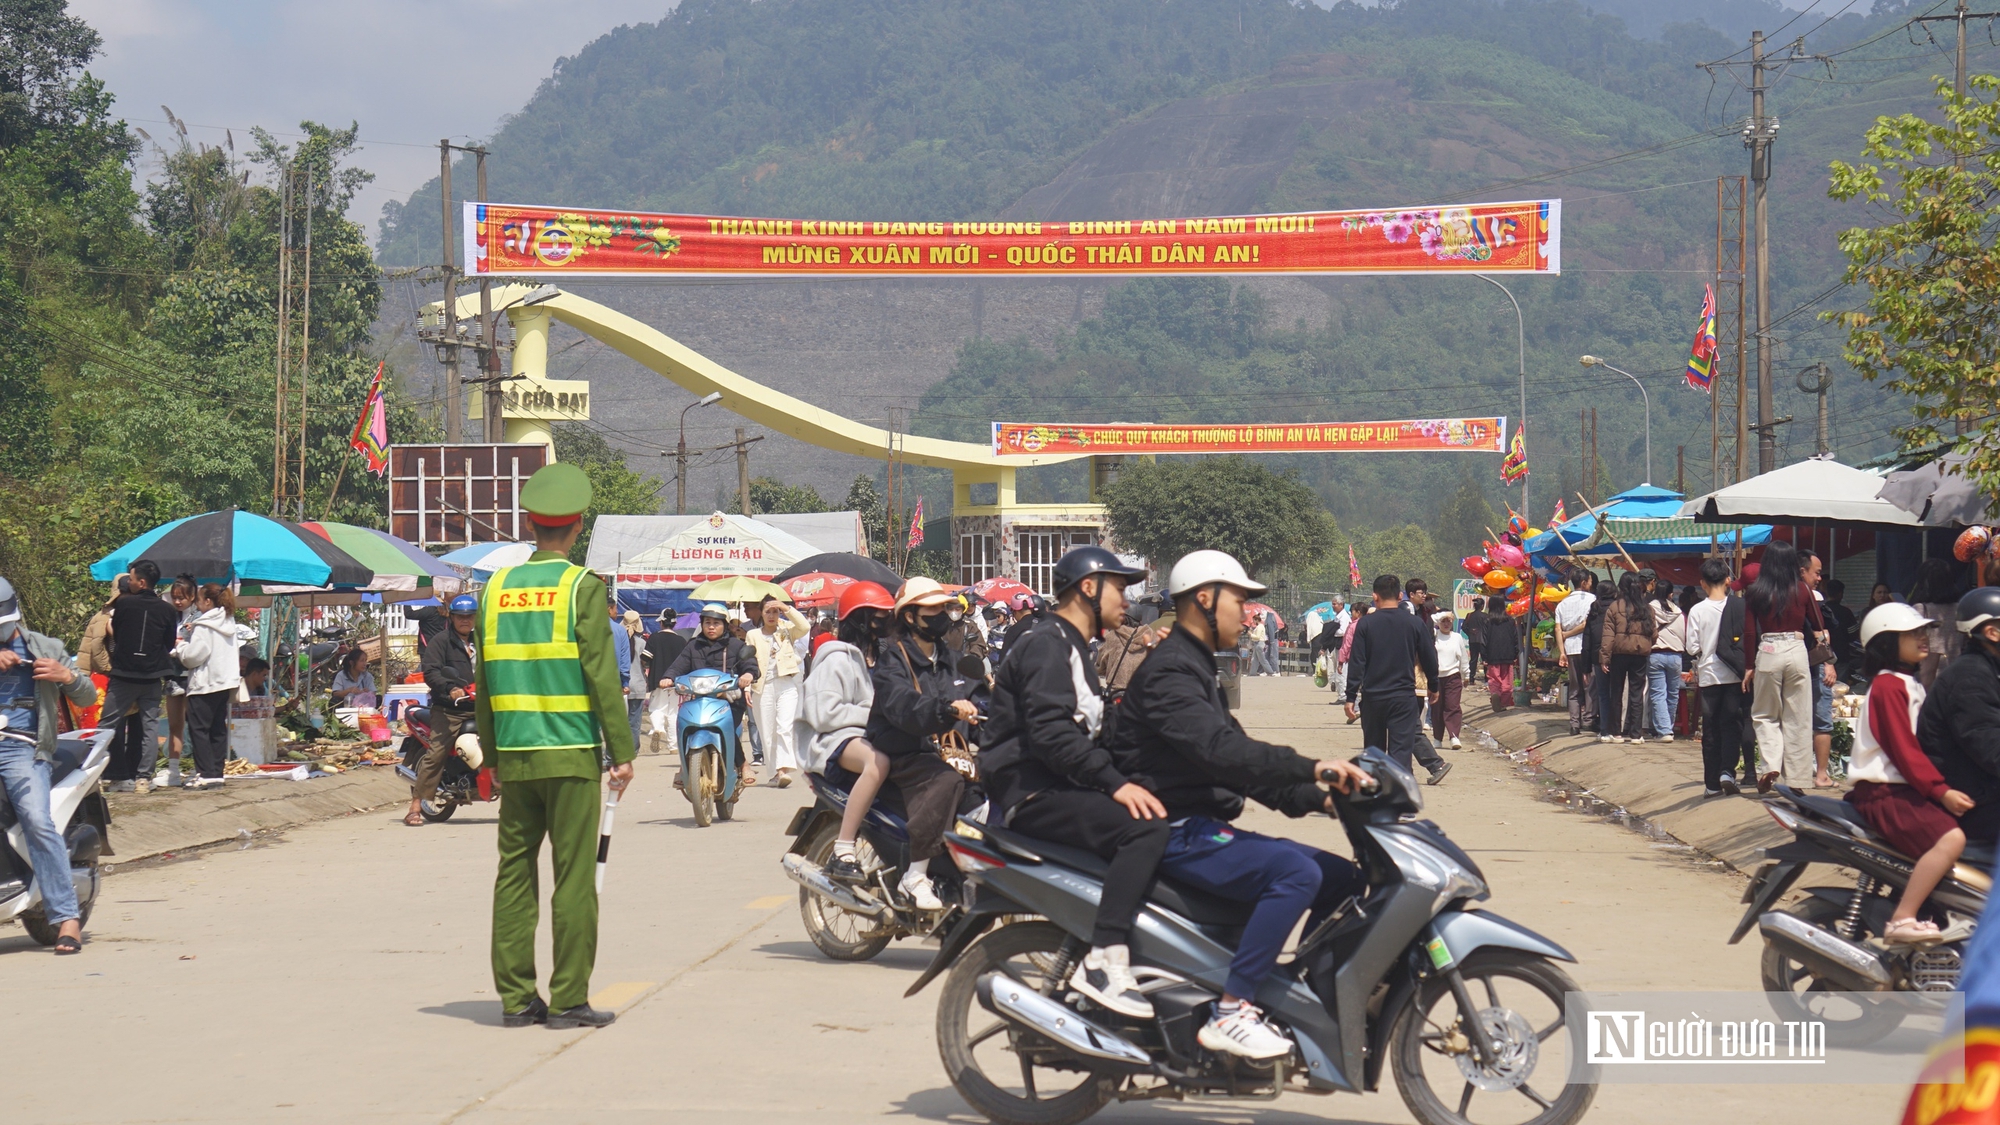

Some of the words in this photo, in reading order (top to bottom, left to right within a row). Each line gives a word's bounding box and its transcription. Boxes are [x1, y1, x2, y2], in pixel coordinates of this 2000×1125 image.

[1139, 220, 1176, 234] AN
[762, 243, 841, 264] MỪNG
[848, 243, 920, 264] XUÂN
[929, 243, 979, 264] MỚI
[1006, 240, 1076, 264] QUỐC
[1085, 242, 1142, 263] THÁI
[1151, 242, 1205, 263] DÂN
[1213, 245, 1259, 263] AN!
[1093, 428, 1123, 445] CHÚC
[1126, 427, 1148, 446] QUÝ
[1151, 427, 1189, 444] KHÁCH
[1192, 428, 1236, 446] THƯỢNG
[1239, 426, 1253, 446] LỘ
[1256, 426, 1284, 443] BÌNH
[1287, 428, 1303, 442] AN
[1306, 425, 1321, 442] VÀ
[1324, 428, 1347, 445] HẸN
[1350, 425, 1374, 445] GẶP
[1376, 427, 1399, 445] LẠI!
[697, 536, 711, 545] SỰ
[713, 536, 736, 545] KIỆN
[671, 547, 724, 559] LƯƠNG
[729, 546, 762, 561] MẬU
[499, 591, 557, 608] C.S.T.T
